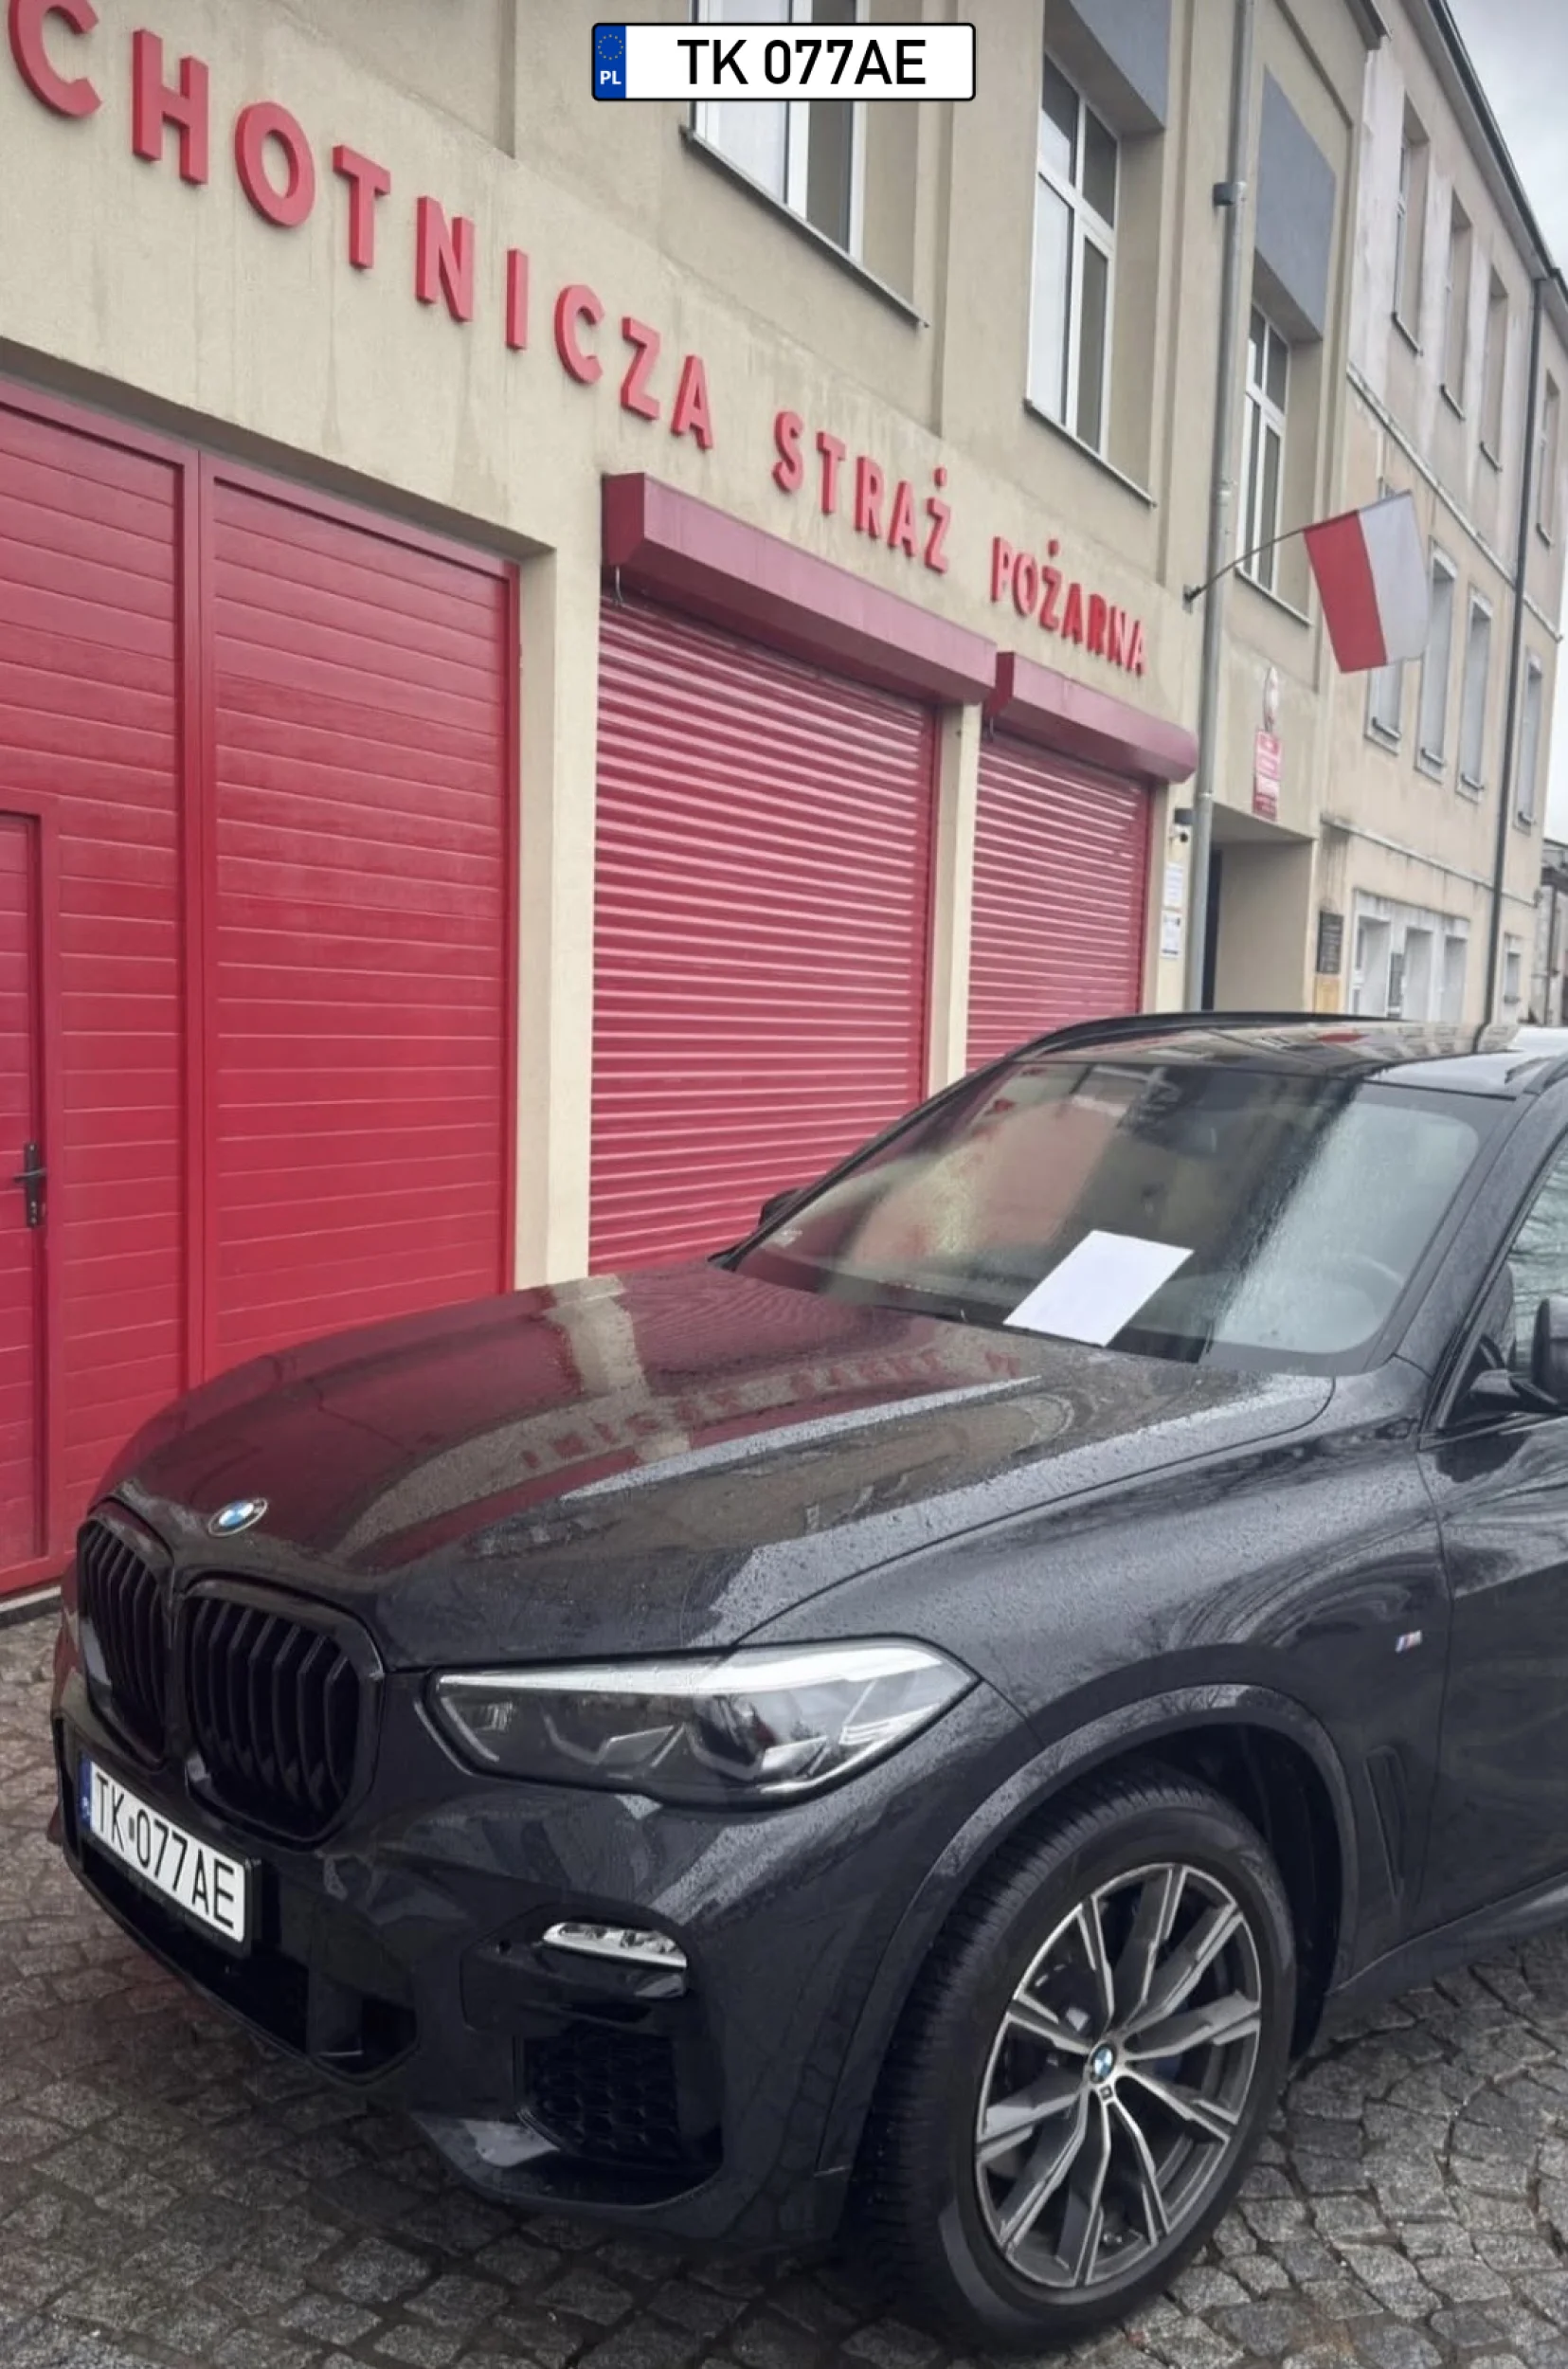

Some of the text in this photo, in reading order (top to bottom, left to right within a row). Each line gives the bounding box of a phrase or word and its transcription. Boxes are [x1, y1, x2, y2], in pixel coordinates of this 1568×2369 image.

[8, 0, 1145, 676] CHOTNICZA STRAŻ POŻARNA
[96, 1770, 235, 1930] TK 077AE
